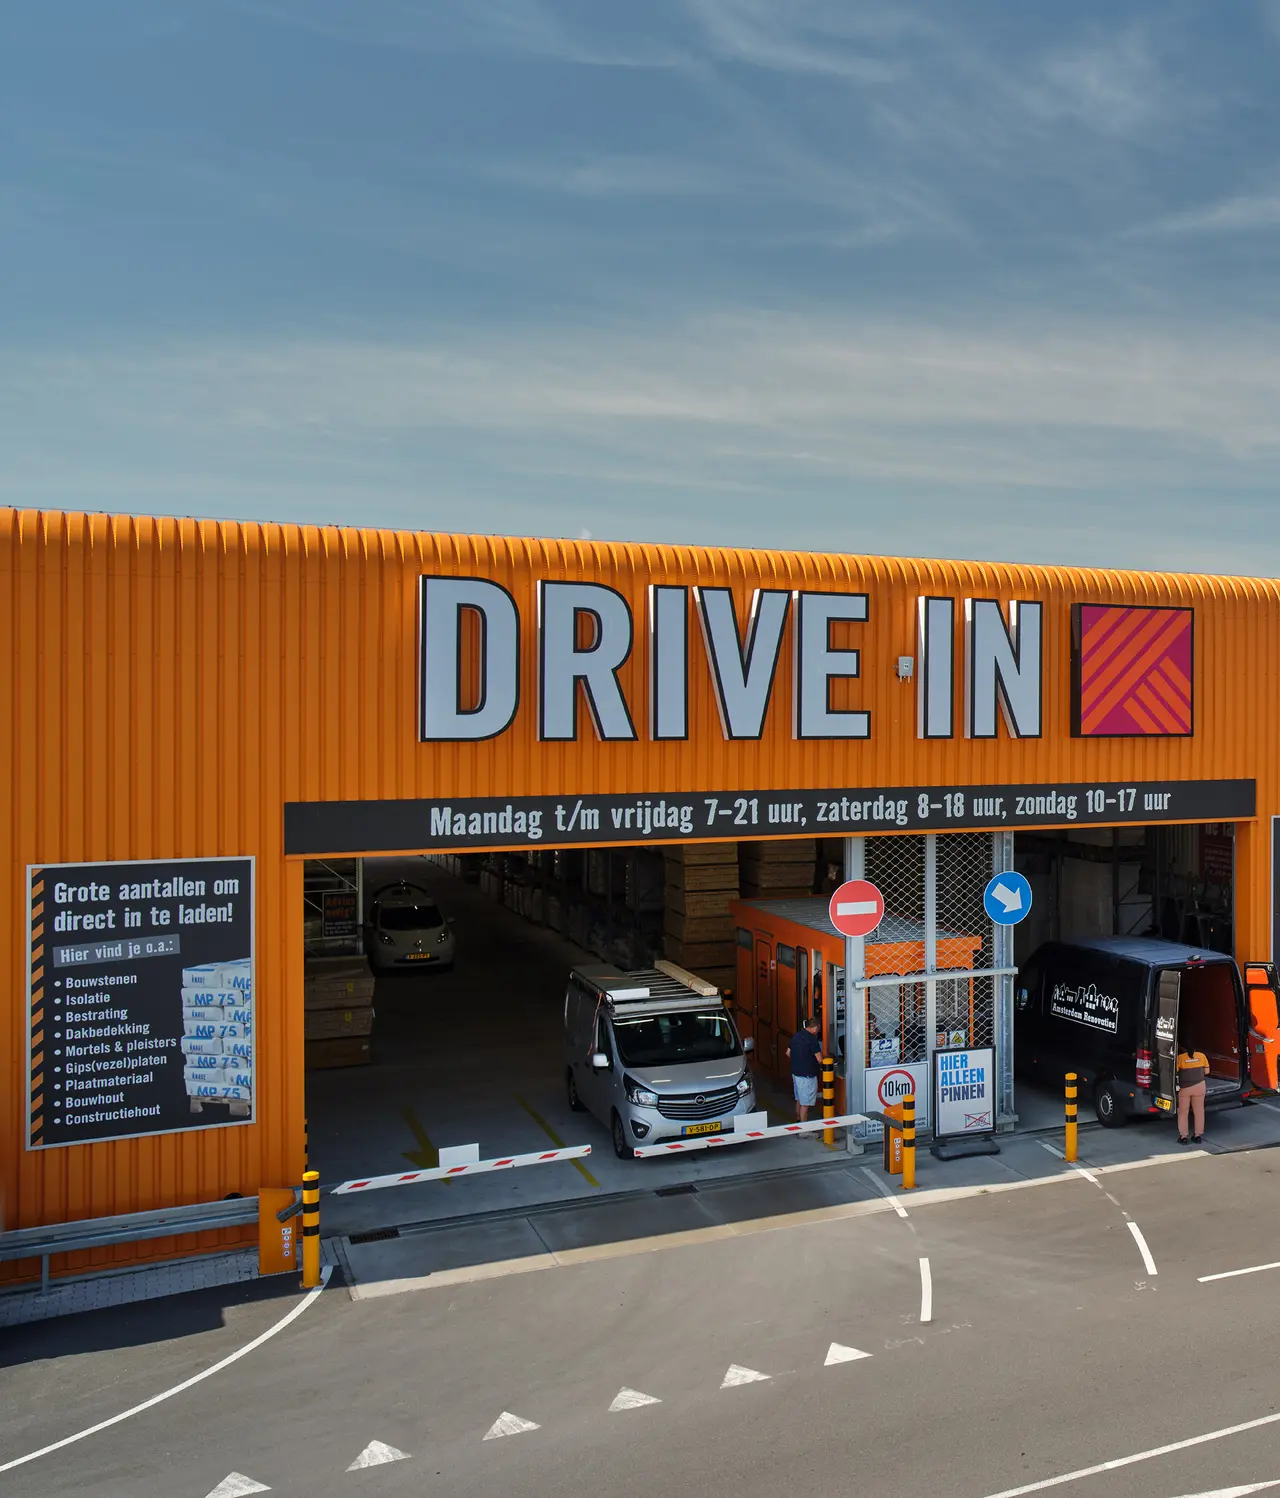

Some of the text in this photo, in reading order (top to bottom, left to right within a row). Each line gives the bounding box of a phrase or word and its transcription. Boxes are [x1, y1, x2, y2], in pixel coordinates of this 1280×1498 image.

[418, 574, 1043, 742] DRIVE IN
[430, 806, 542, 839] Maandag
[554, 801, 600, 831] t/m
[611, 800, 694, 833] vrijdag
[767, 799, 808, 827] uur,
[816, 794, 908, 826] zaterdag
[972, 794, 1007, 820] uur,
[1015, 791, 1077, 820] zondag
[1143, 791, 1172, 811] uur
[54, 876, 240, 903] Grote aantallen om
[54, 902, 233, 932] direct in te laden!
[60, 947, 89, 963] Hier
[95, 943, 122, 959] vind
[127, 942, 141, 959] je
[65, 974, 137, 989] Bouwstenen
[66, 992, 111, 1006] Isolatie
[194, 993, 236, 1005] MP 75
[65, 1008, 128, 1023] Bestrating
[1052, 1002, 1115, 1029] Amsterdam Renovaties
[65, 1023, 150, 1040] Dakbedekking
[195, 1025, 237, 1037] MP 75
[65, 1037, 177, 1057] Mortels & pleisters
[65, 1055, 167, 1075] Gips(vezel)platen
[221, 1057, 239, 1068] 75
[940, 1053, 968, 1071] HIER
[65, 1071, 153, 1091] Plaatmateriaal
[941, 1068, 985, 1087] ALLEEN
[65, 1092, 125, 1109] Bouwhout
[222, 1087, 240, 1099] 75
[941, 1083, 985, 1103] PINNEN
[65, 1104, 161, 1125] Constructiehout
